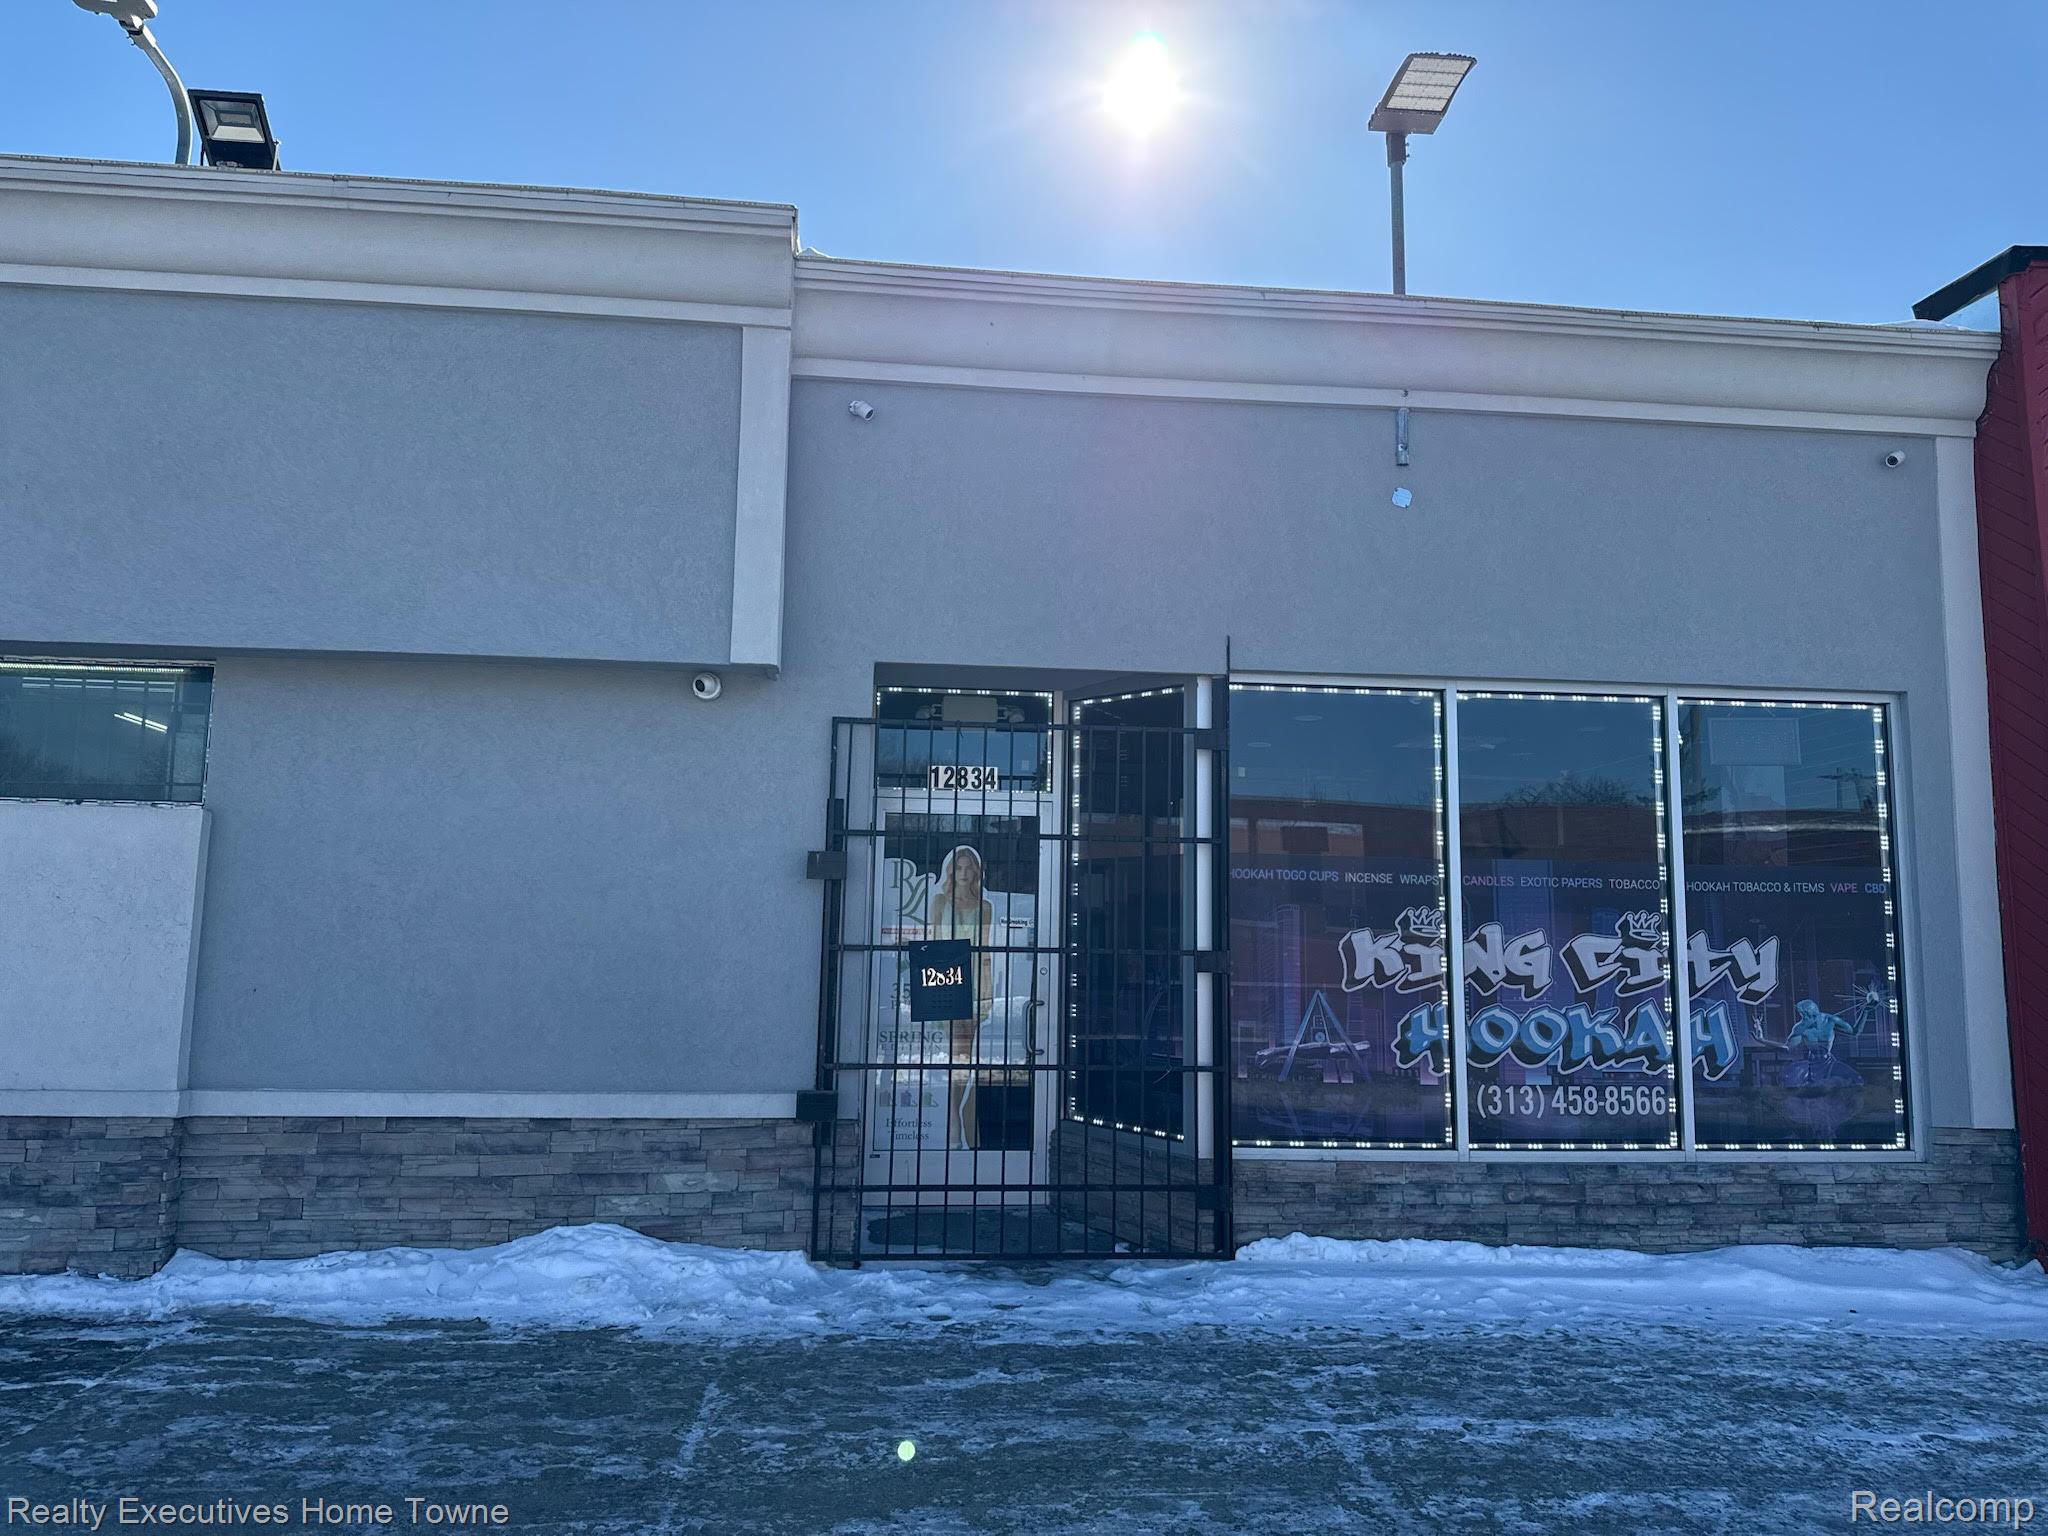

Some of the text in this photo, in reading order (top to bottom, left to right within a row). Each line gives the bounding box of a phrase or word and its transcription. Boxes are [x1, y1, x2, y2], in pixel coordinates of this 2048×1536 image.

[931, 766, 997, 790] 12834
[1276, 869, 1307, 881] TOGO
[1309, 870, 1339, 882] CUPS
[1345, 872, 1393, 884] INCENSE
[1400, 874, 1440, 886] WRAPS
[1463, 875, 1514, 887] CANDLES
[1520, 876, 1559, 888] EXOTIC
[1562, 877, 1603, 889] PAPERS
[1609, 879, 1660, 890] TOBACCO
[1686, 881, 1731, 892] HOOKAH
[1732, 881, 1782, 893] TOBACCO
[1783, 881, 1792, 893] &
[1793, 882, 1825, 893] ITEMS
[1830, 882, 1858, 894] VAPE
[1864, 883, 1887, 894] CBD
[1391, 997, 1740, 1081] HOOKAH
[1476, 1084, 1667, 1120] (313) 458-8566
